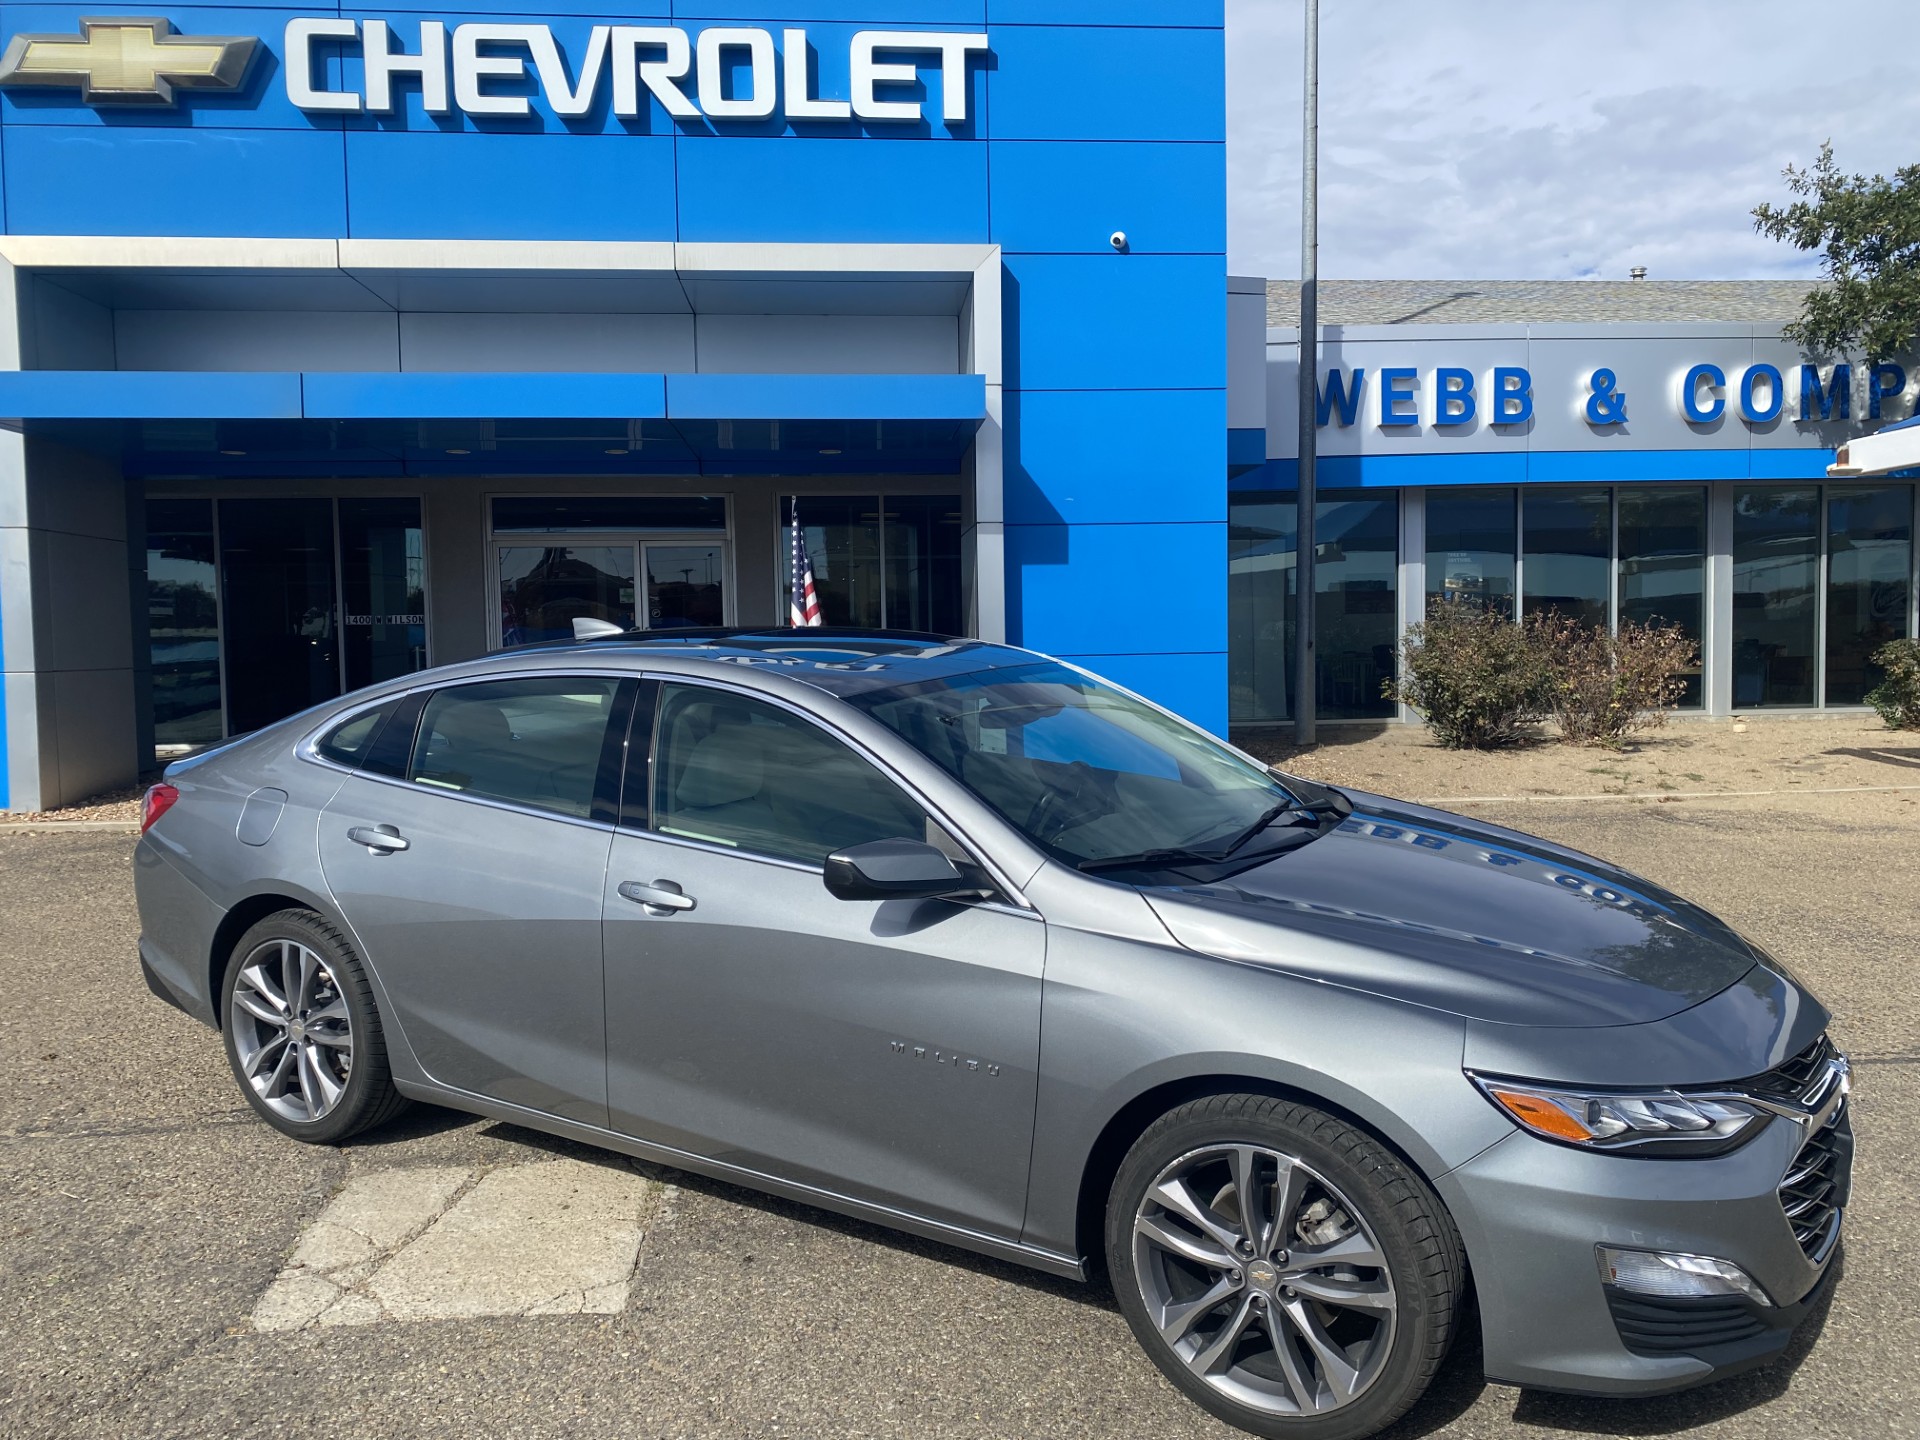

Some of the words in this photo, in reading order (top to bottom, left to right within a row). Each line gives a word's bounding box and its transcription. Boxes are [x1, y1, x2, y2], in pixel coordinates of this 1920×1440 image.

[284, 18, 990, 123] CHEVROLET
[1316, 367, 1533, 425] WEBB
[1586, 367, 1628, 425] &
[1681, 363, 1920, 423] COMP
[347, 616, 371, 625] 1400
[387, 615, 424, 624] WILSON
